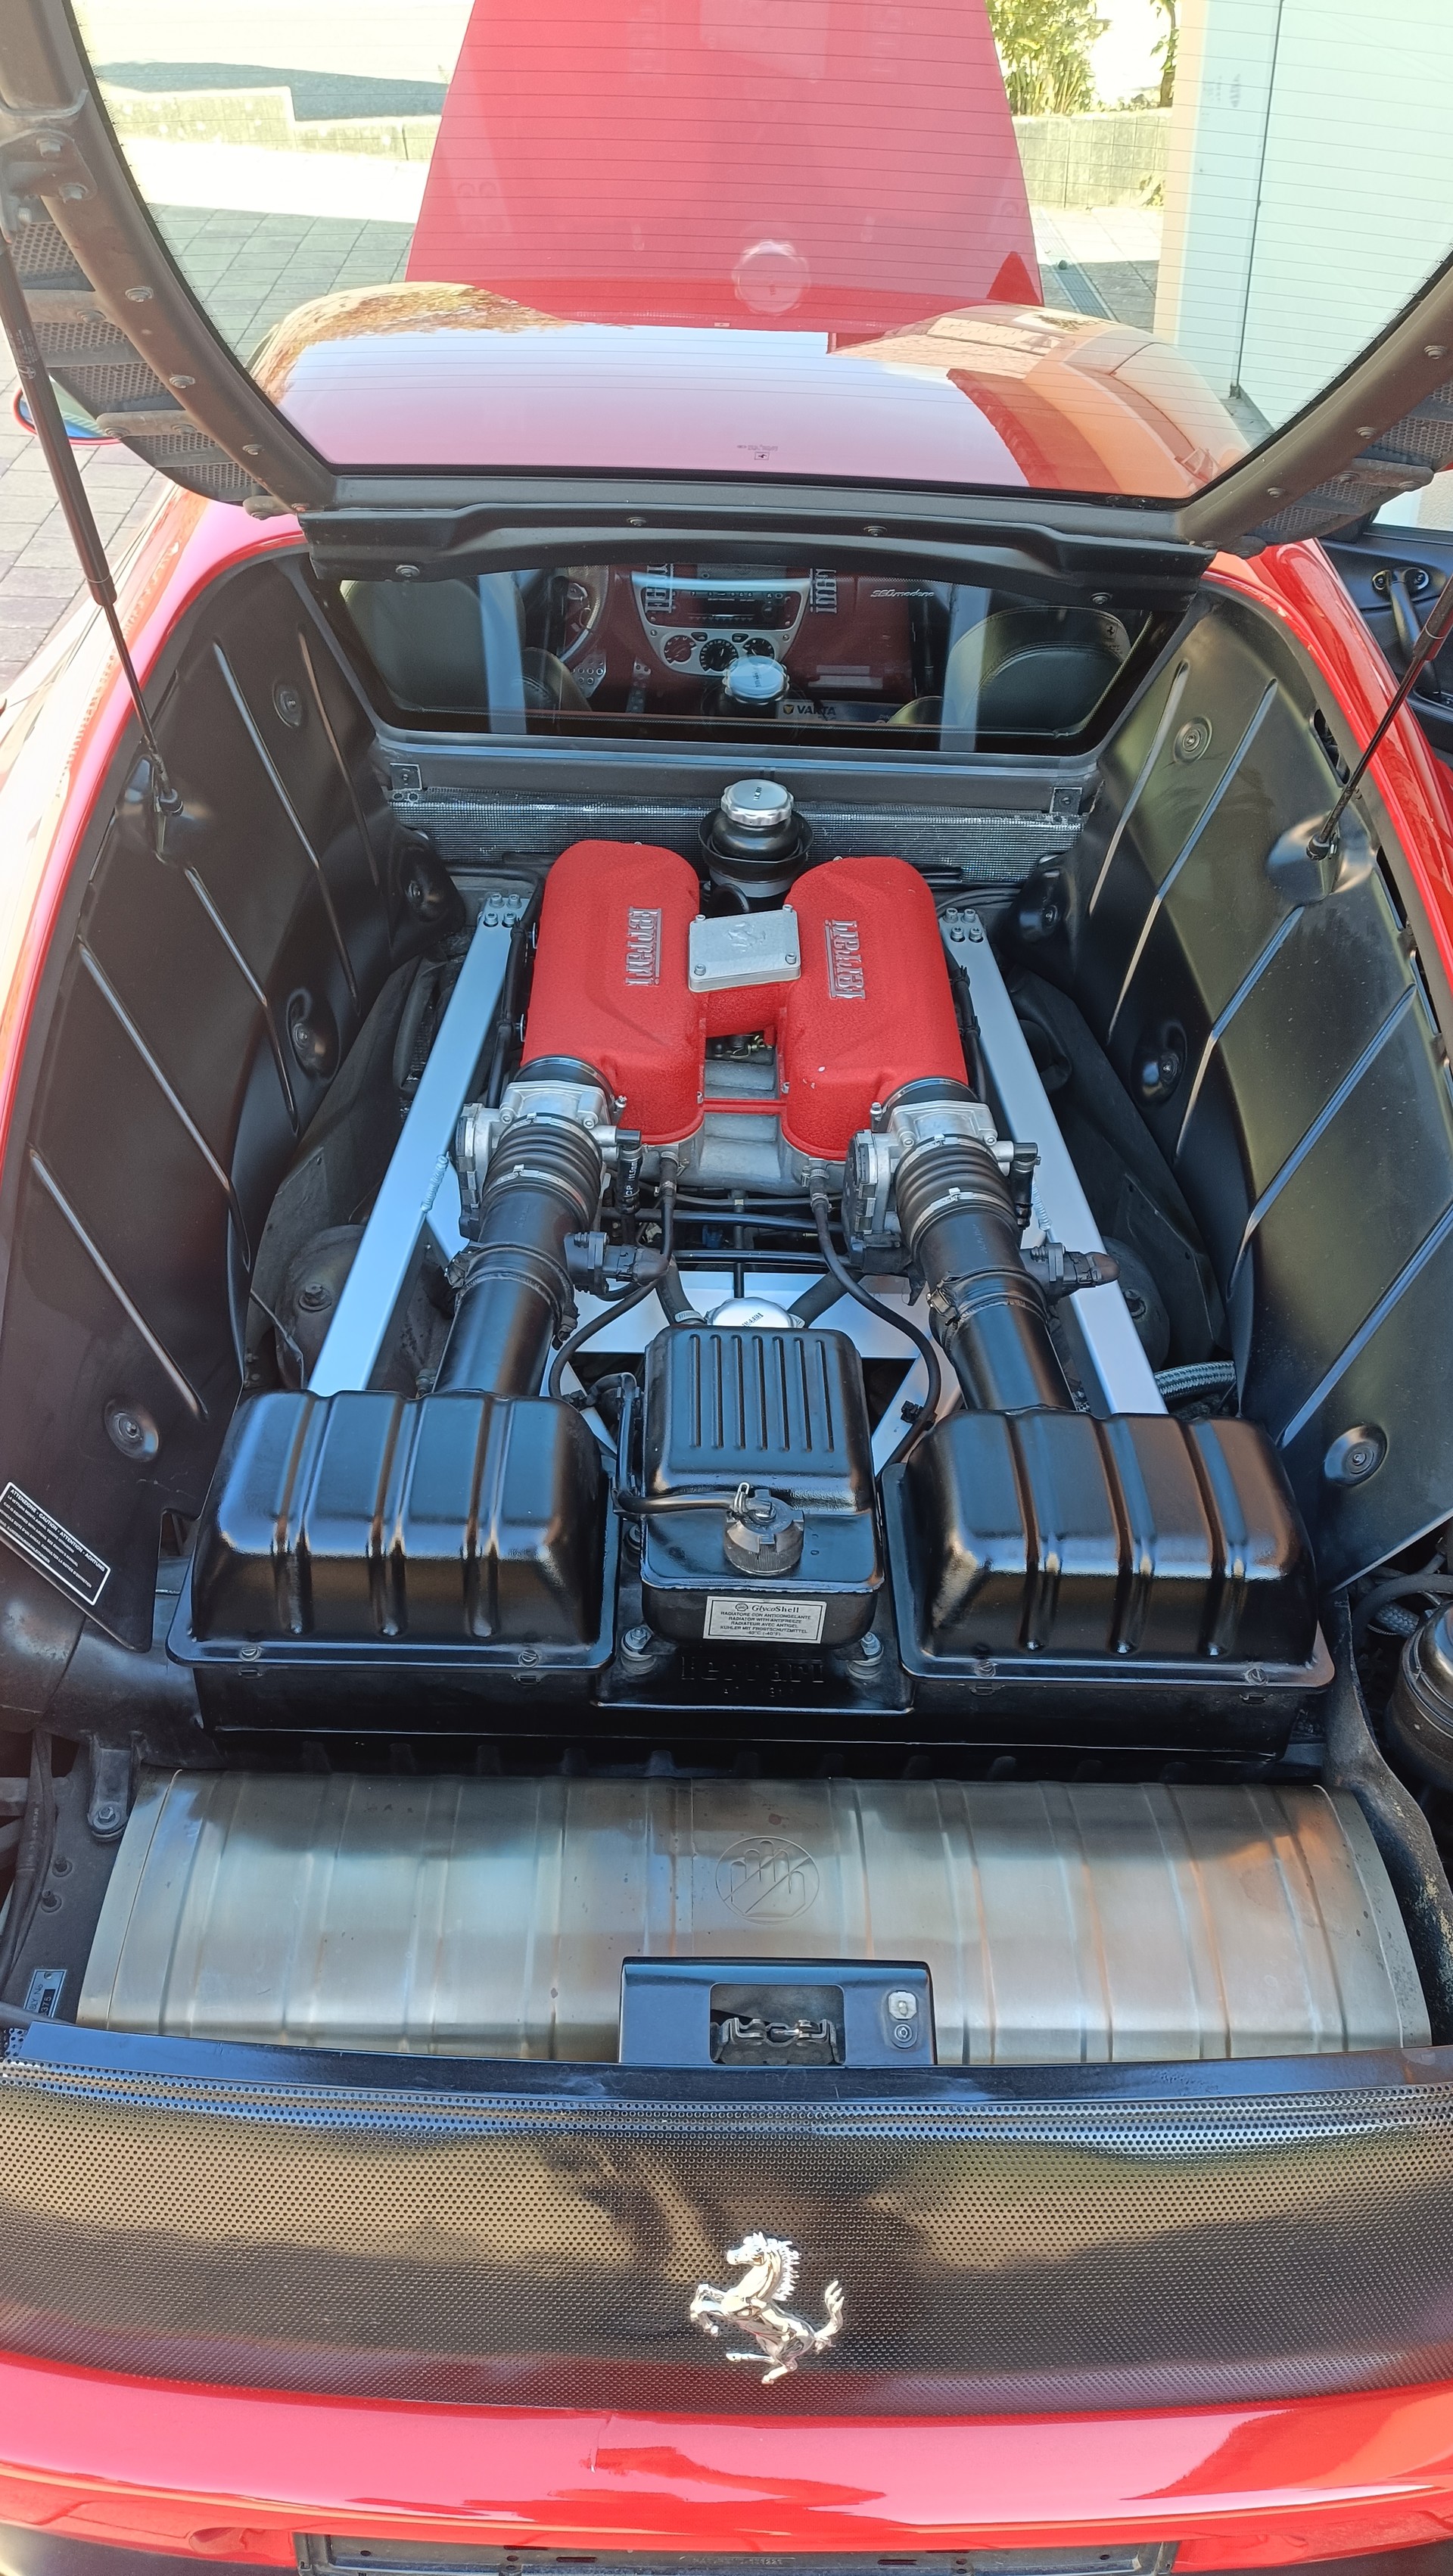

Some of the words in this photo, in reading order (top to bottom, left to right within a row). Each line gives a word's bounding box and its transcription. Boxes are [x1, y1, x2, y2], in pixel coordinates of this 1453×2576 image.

[624, 906, 661, 986] Ferrari
[824, 919, 866, 1000] Ferrari
[9, 1489, 37, 1513] ATTENZIONE
[38, 1513, 58, 1531] CAUTION
[59, 1531, 83, 1553] ATTENTION
[84, 1552, 105, 1572] ACHTUNG
